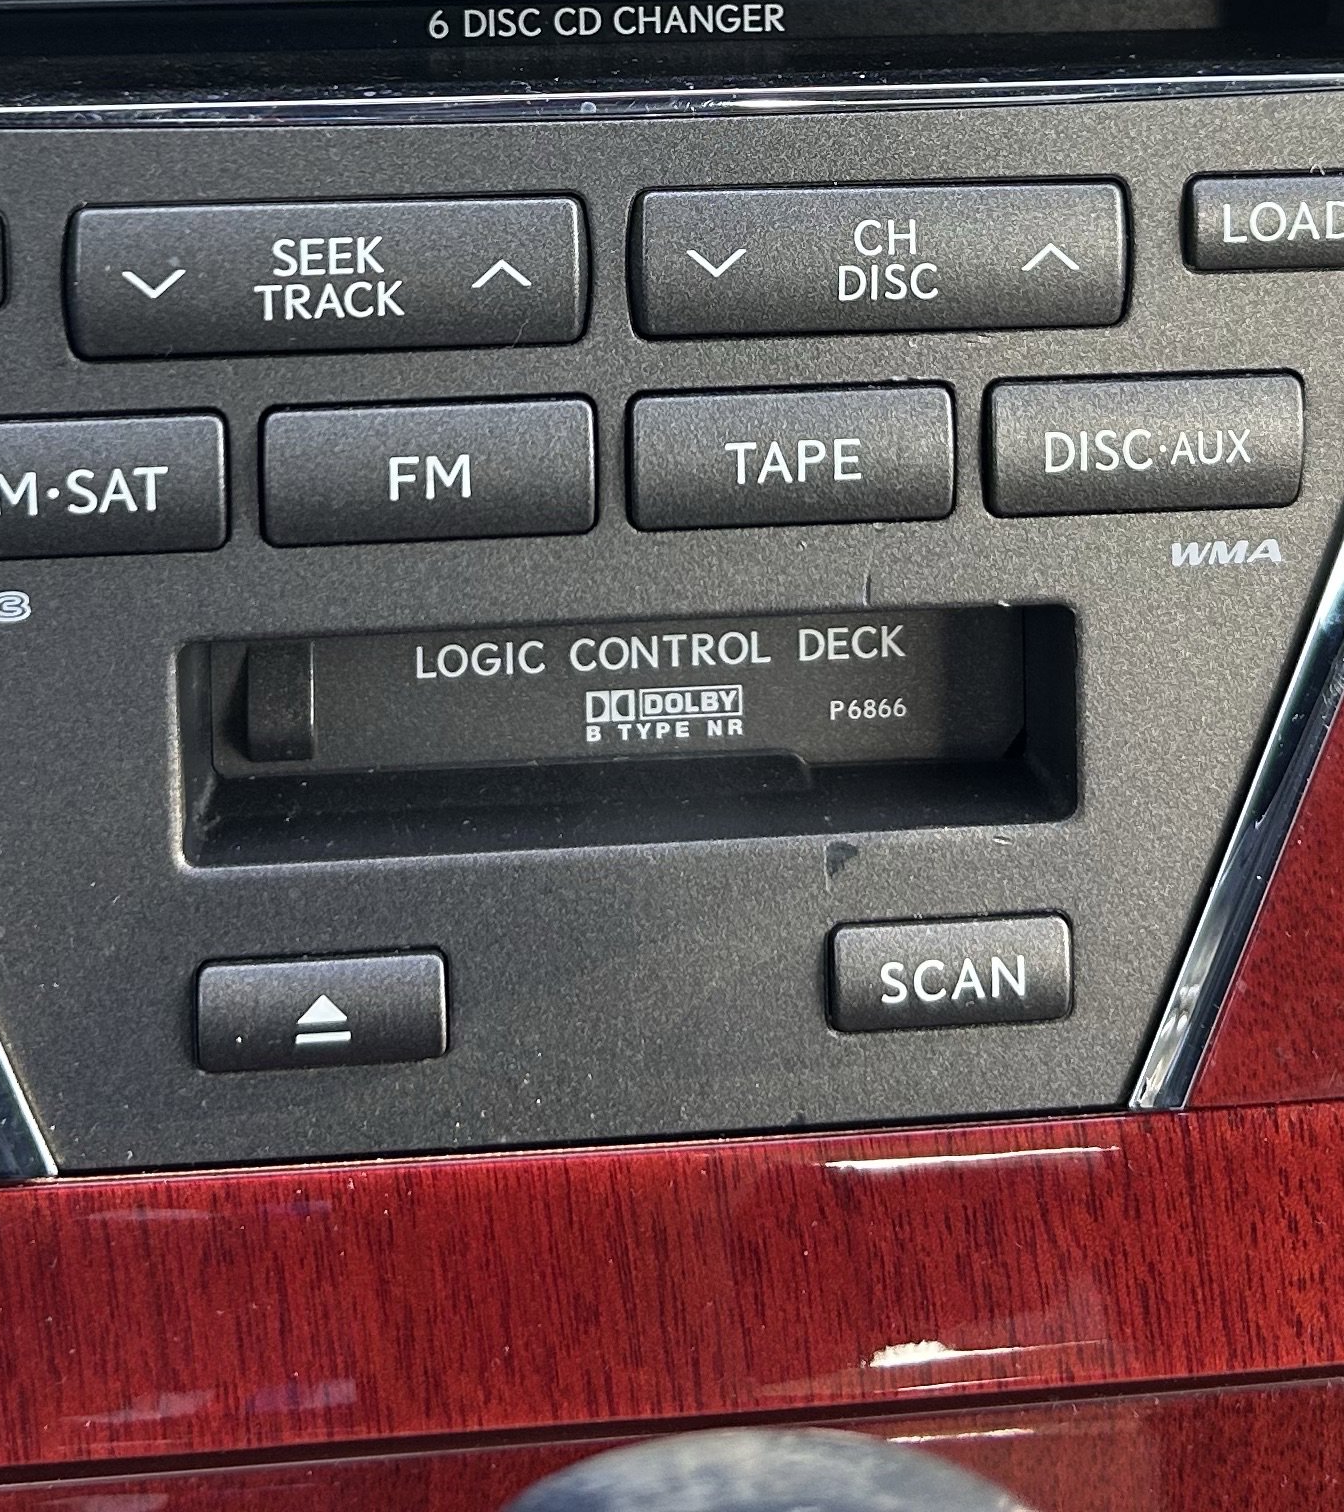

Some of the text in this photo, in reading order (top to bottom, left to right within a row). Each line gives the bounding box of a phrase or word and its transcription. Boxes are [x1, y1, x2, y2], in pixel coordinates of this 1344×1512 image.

[428, 3, 785, 39] 6 DISC CD CHANGER
[272, 236, 385, 277] SEEK
[854, 218, 917, 257] CH
[253, 280, 405, 321] TRACK
[838, 262, 939, 301] DISC
[388, 454, 471, 501] FM
[724, 438, 862, 485] TAPE
[1171, 538, 1286, 567] WMA
[416, 625, 905, 679] LOGIC CONTROL DECK
[642, 689, 738, 716] DOLBY
[830, 698, 907, 721] P6866
[586, 717, 744, 742] B TYPE NR
[879, 954, 1027, 1005] SCAN
